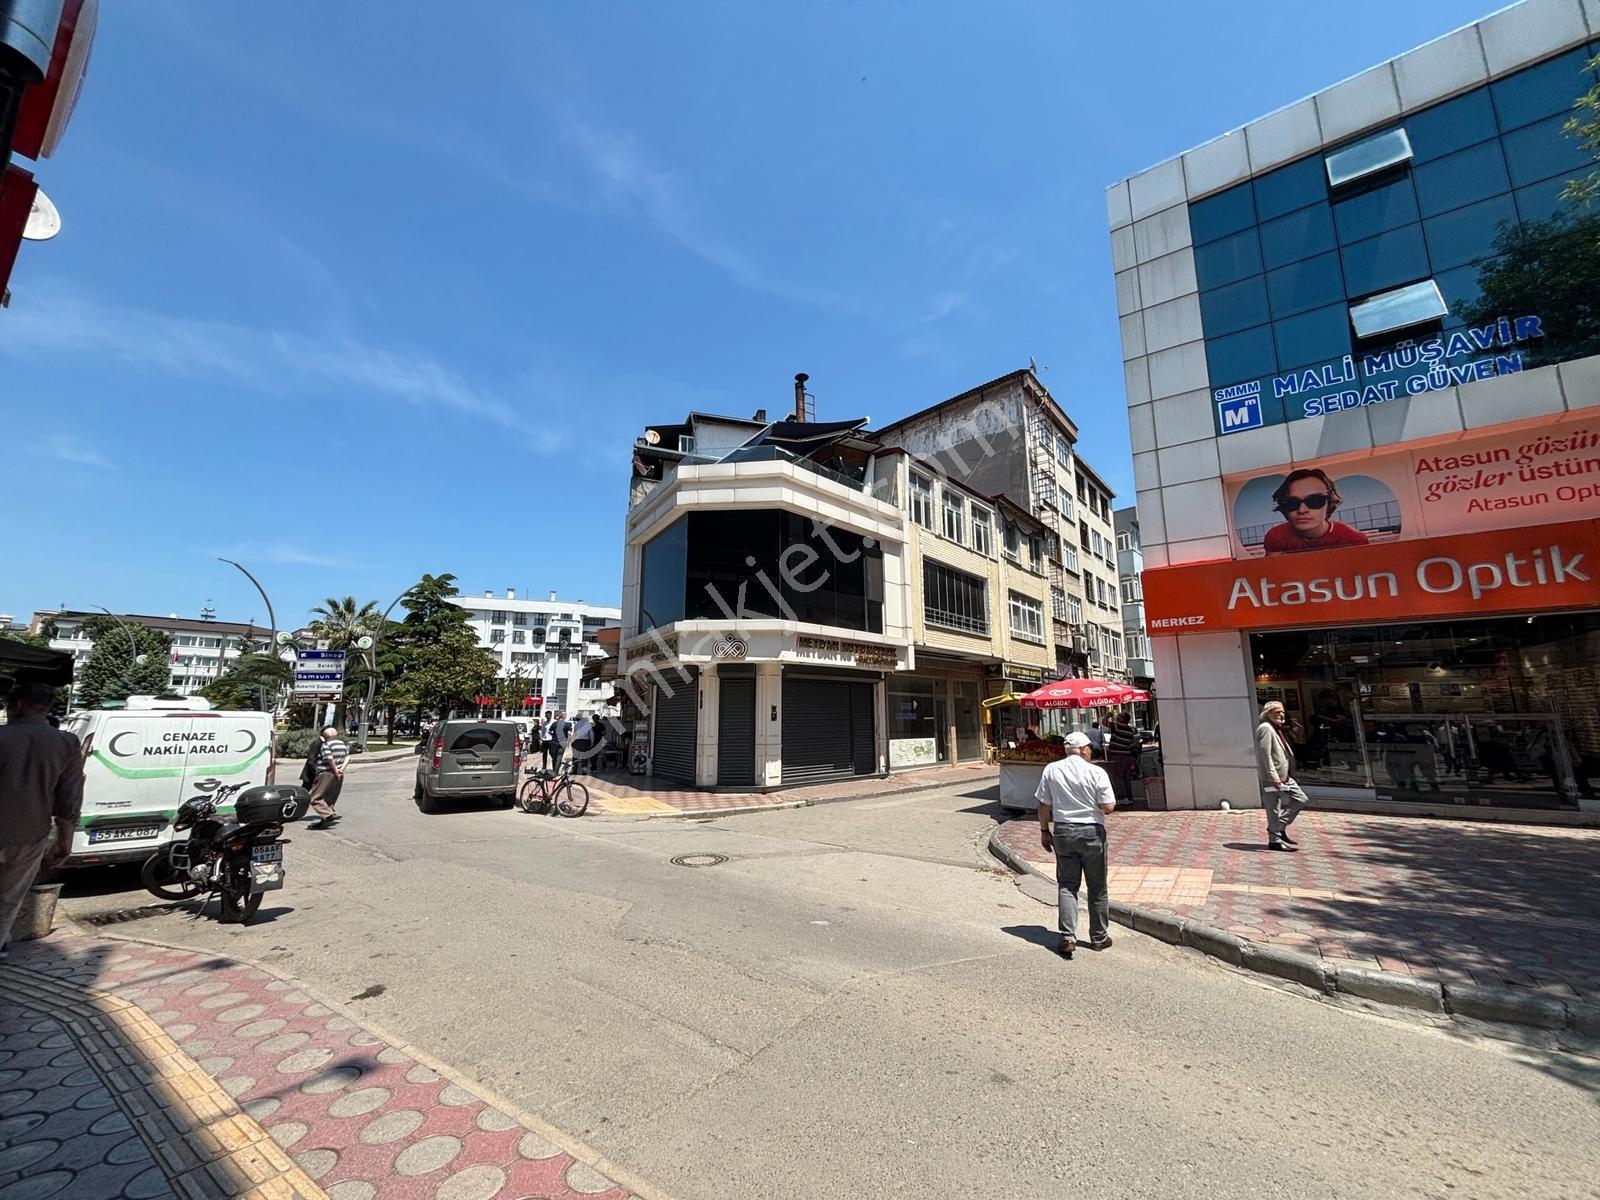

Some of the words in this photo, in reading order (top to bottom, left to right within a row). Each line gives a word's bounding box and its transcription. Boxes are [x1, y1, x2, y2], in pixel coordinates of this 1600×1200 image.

[1273, 354, 1355, 398] MALİ
[1364, 315, 1544, 377] MÜŞAVİR
[1215, 380, 1261, 401] SMMM
[1304, 381, 1398, 418] SEDAT
[1406, 353, 1523, 396] GÜVEN
[1415, 448, 1511, 475] Atasun
[1425, 470, 1513, 502] gözler
[1467, 492, 1549, 513] Atasun
[1227, 572, 1399, 610] Atasun
[1416, 545, 1591, 600] Optik
[1151, 615, 1205, 629] MERKEZ
[796, 636, 840, 651] MEYDAN
[163, 732, 216, 741] CENAZE
[143, 743, 186, 755] NAKİL
[189, 744, 229, 754] ARACI
[97, 830, 111, 840] 55
[136, 826, 157, 836] 087
